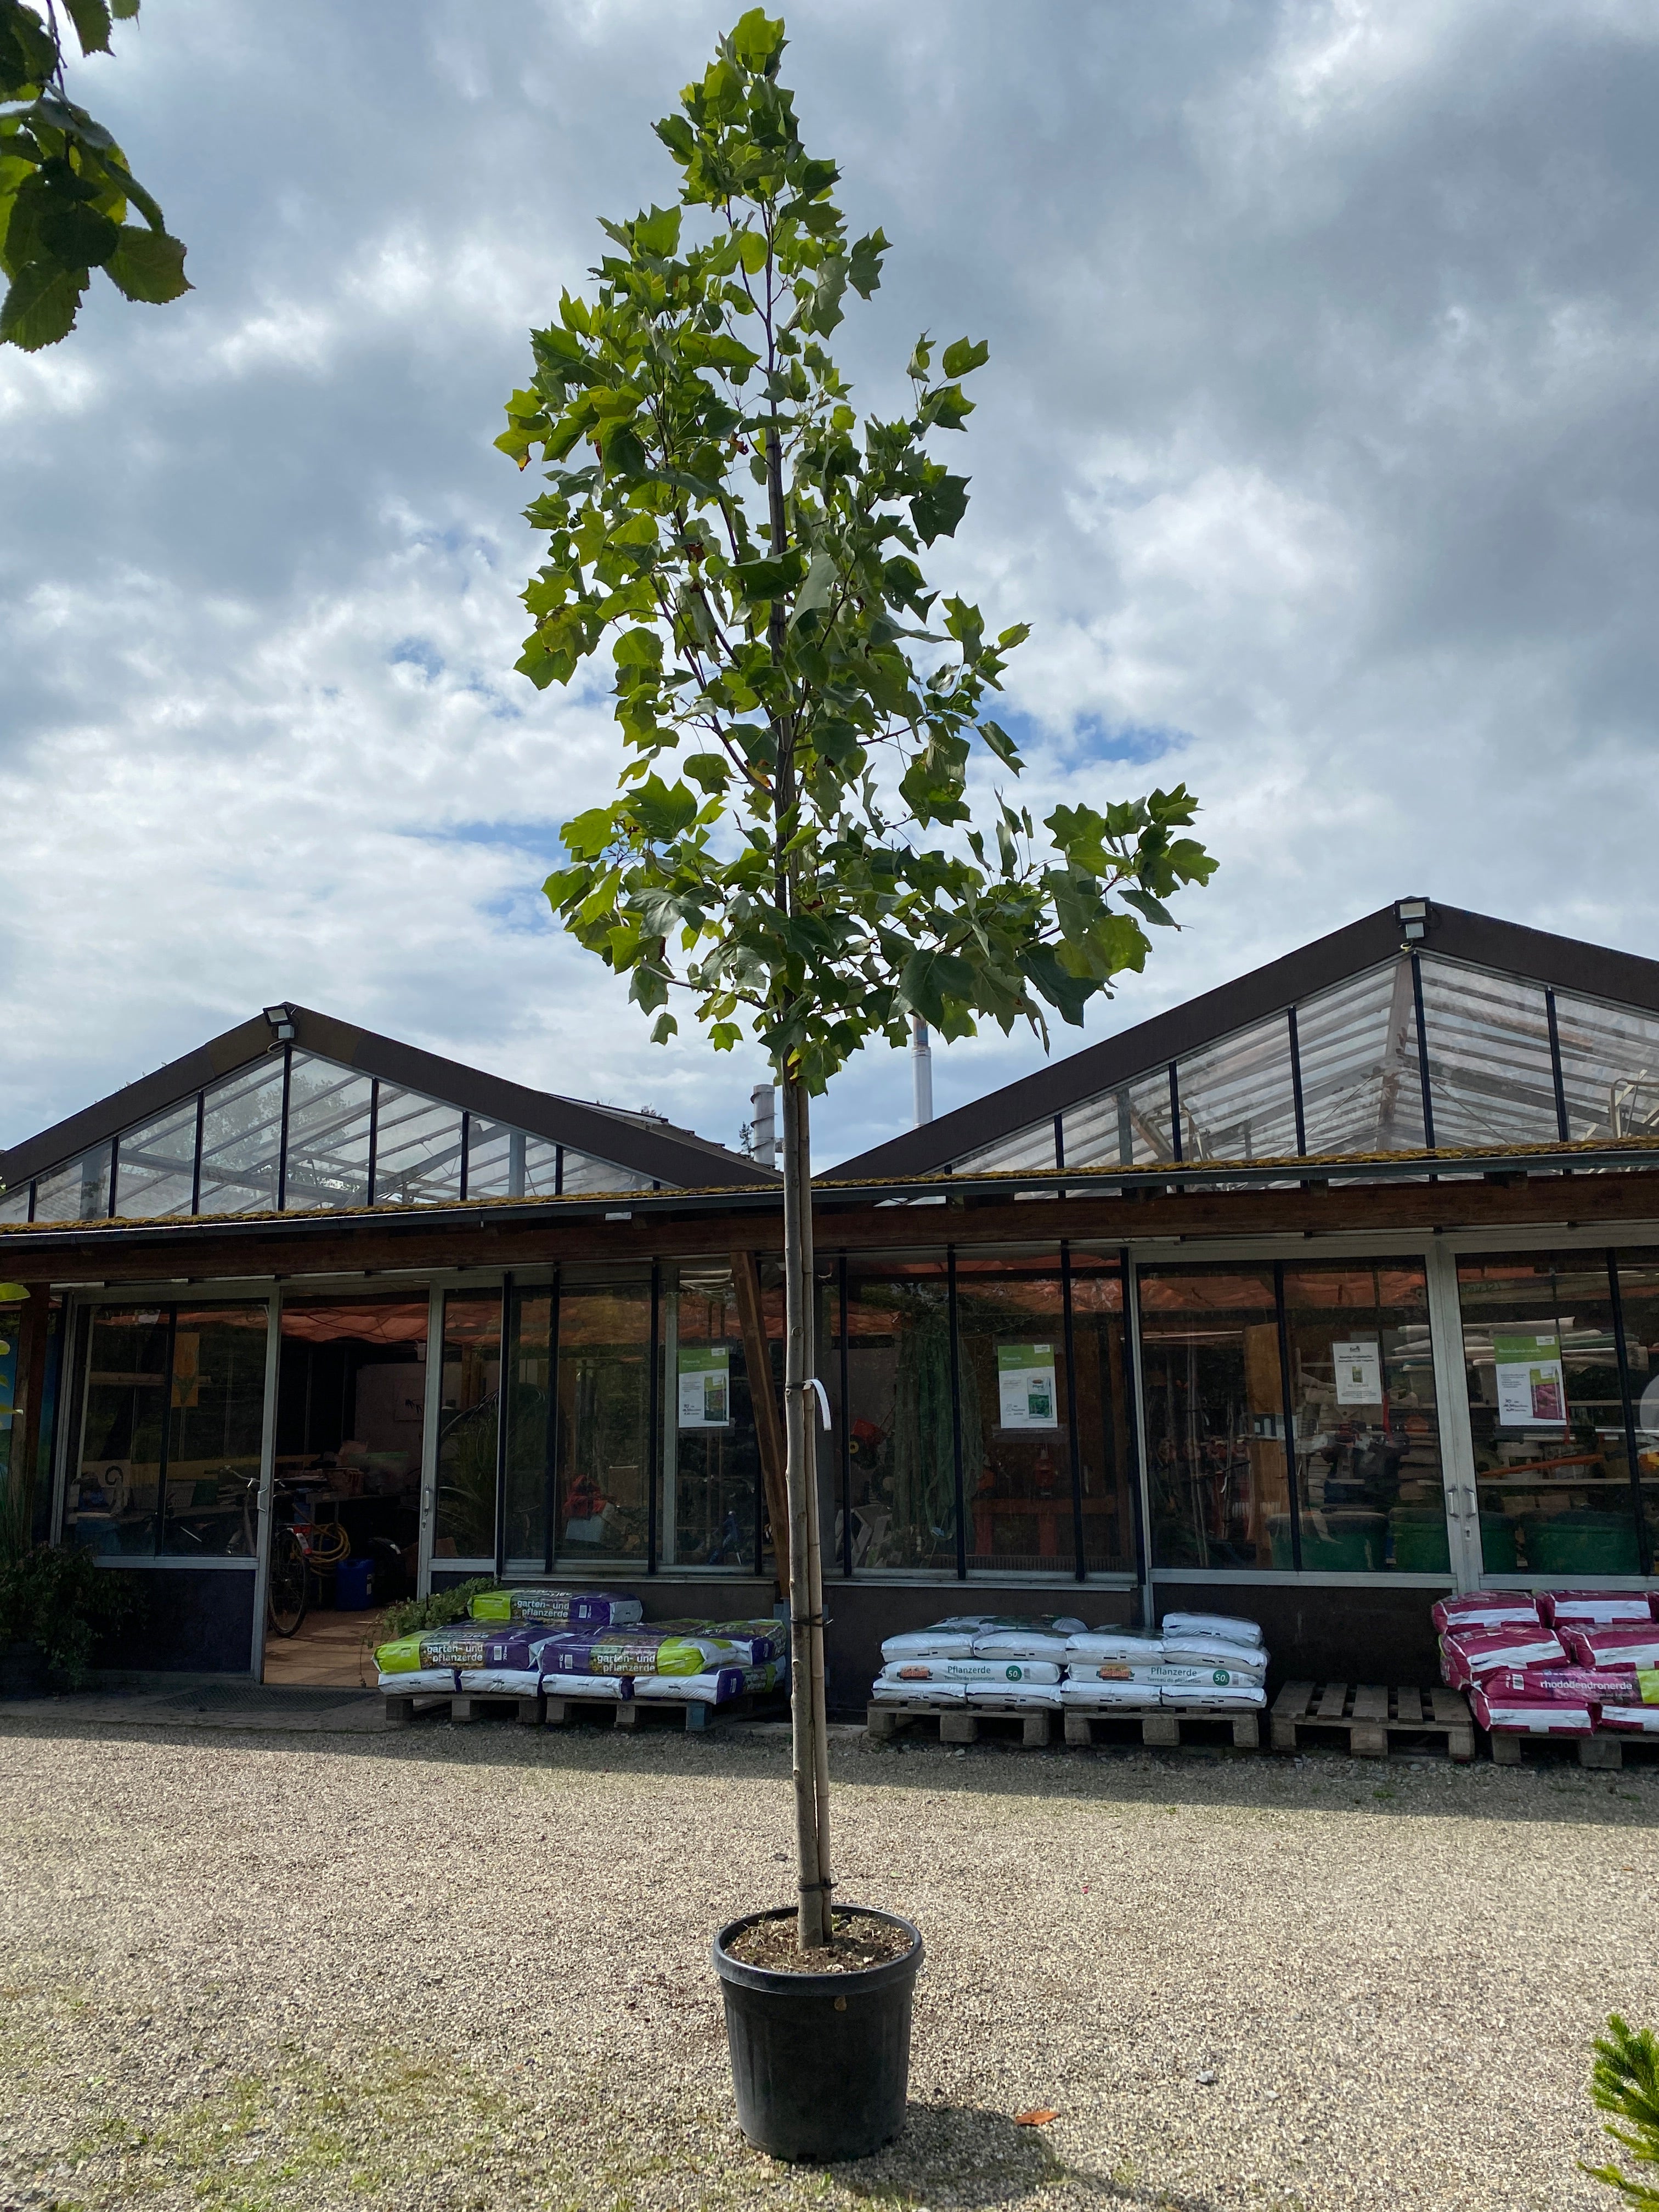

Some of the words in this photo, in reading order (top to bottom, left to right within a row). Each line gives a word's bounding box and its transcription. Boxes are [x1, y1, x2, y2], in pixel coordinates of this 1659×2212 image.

[522, 1608, 568, 1617] pflanzerde
[427, 1645, 463, 1655] garten-
[466, 1644, 483, 1652] und
[432, 1653, 483, 1662] pflanzerde
[597, 1654, 634, 1664] garten-
[603, 1663, 656, 1673] pflanzerde
[947, 1666, 991, 1674] Pflanzerde
[1151, 1667, 1198, 1677] Pflanzerde
